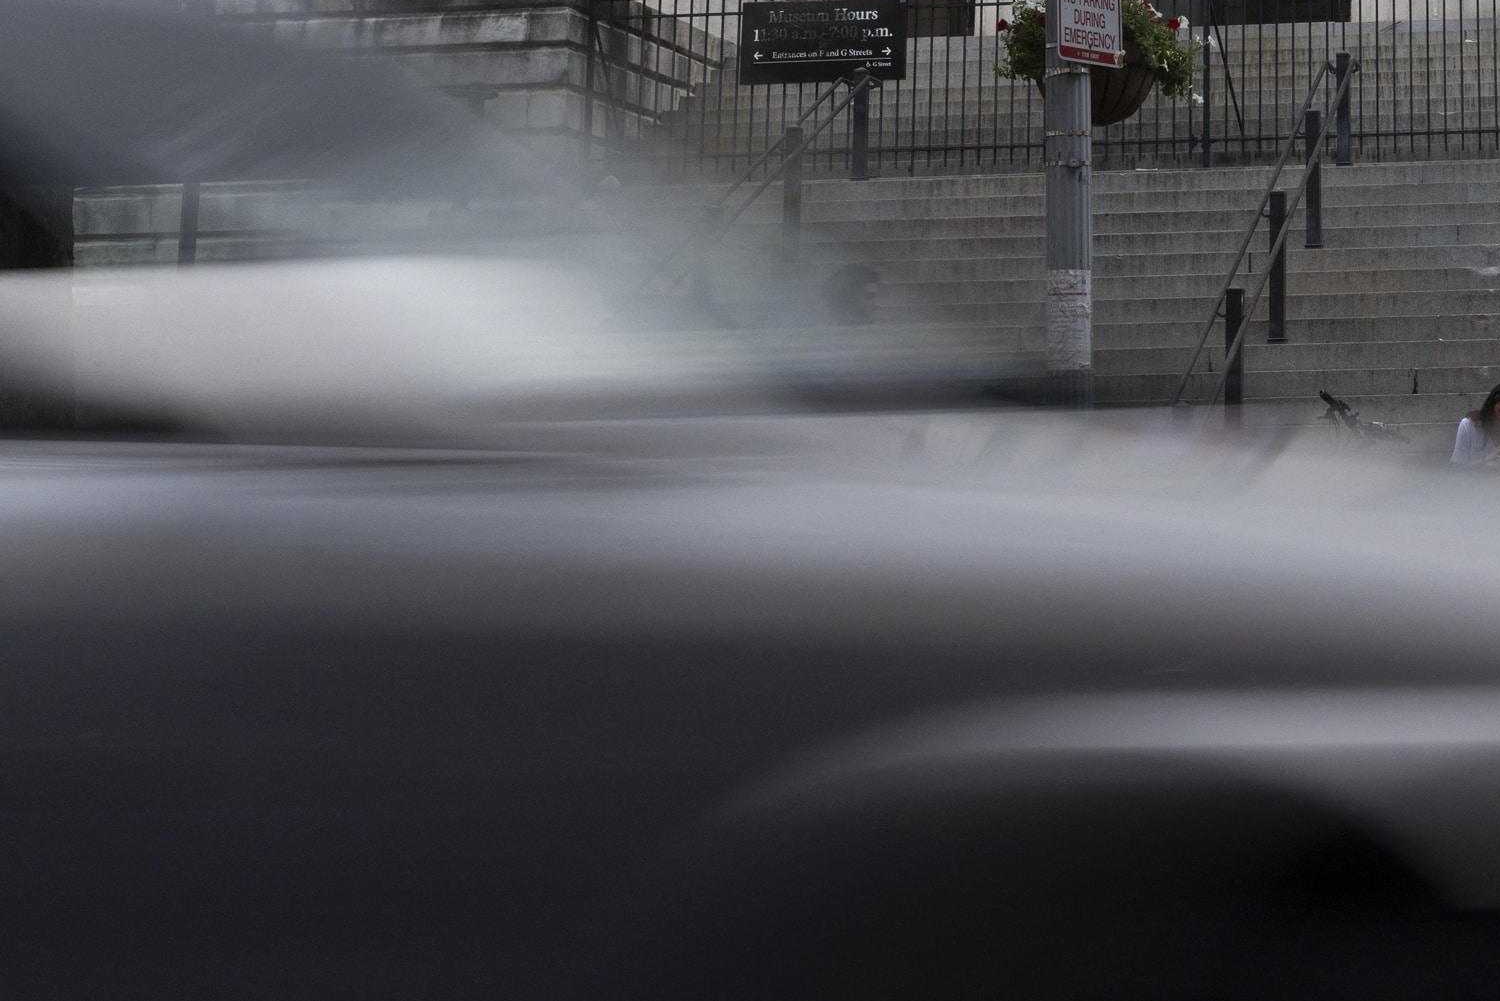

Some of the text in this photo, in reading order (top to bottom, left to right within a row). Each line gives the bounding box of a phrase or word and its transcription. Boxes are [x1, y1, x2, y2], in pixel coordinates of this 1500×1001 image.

[769, 7, 879, 24] Museum Hours
[1074, 8, 1106, 30] DURING
[753, 27, 788, 42] 11:30
[860, 26, 894, 42] p.m.
[1064, 26, 1116, 50] EMERGENCY
[772, 51, 807, 60] Entrances
[826, 49, 839, 57] and
[848, 48, 873, 56] Streets
